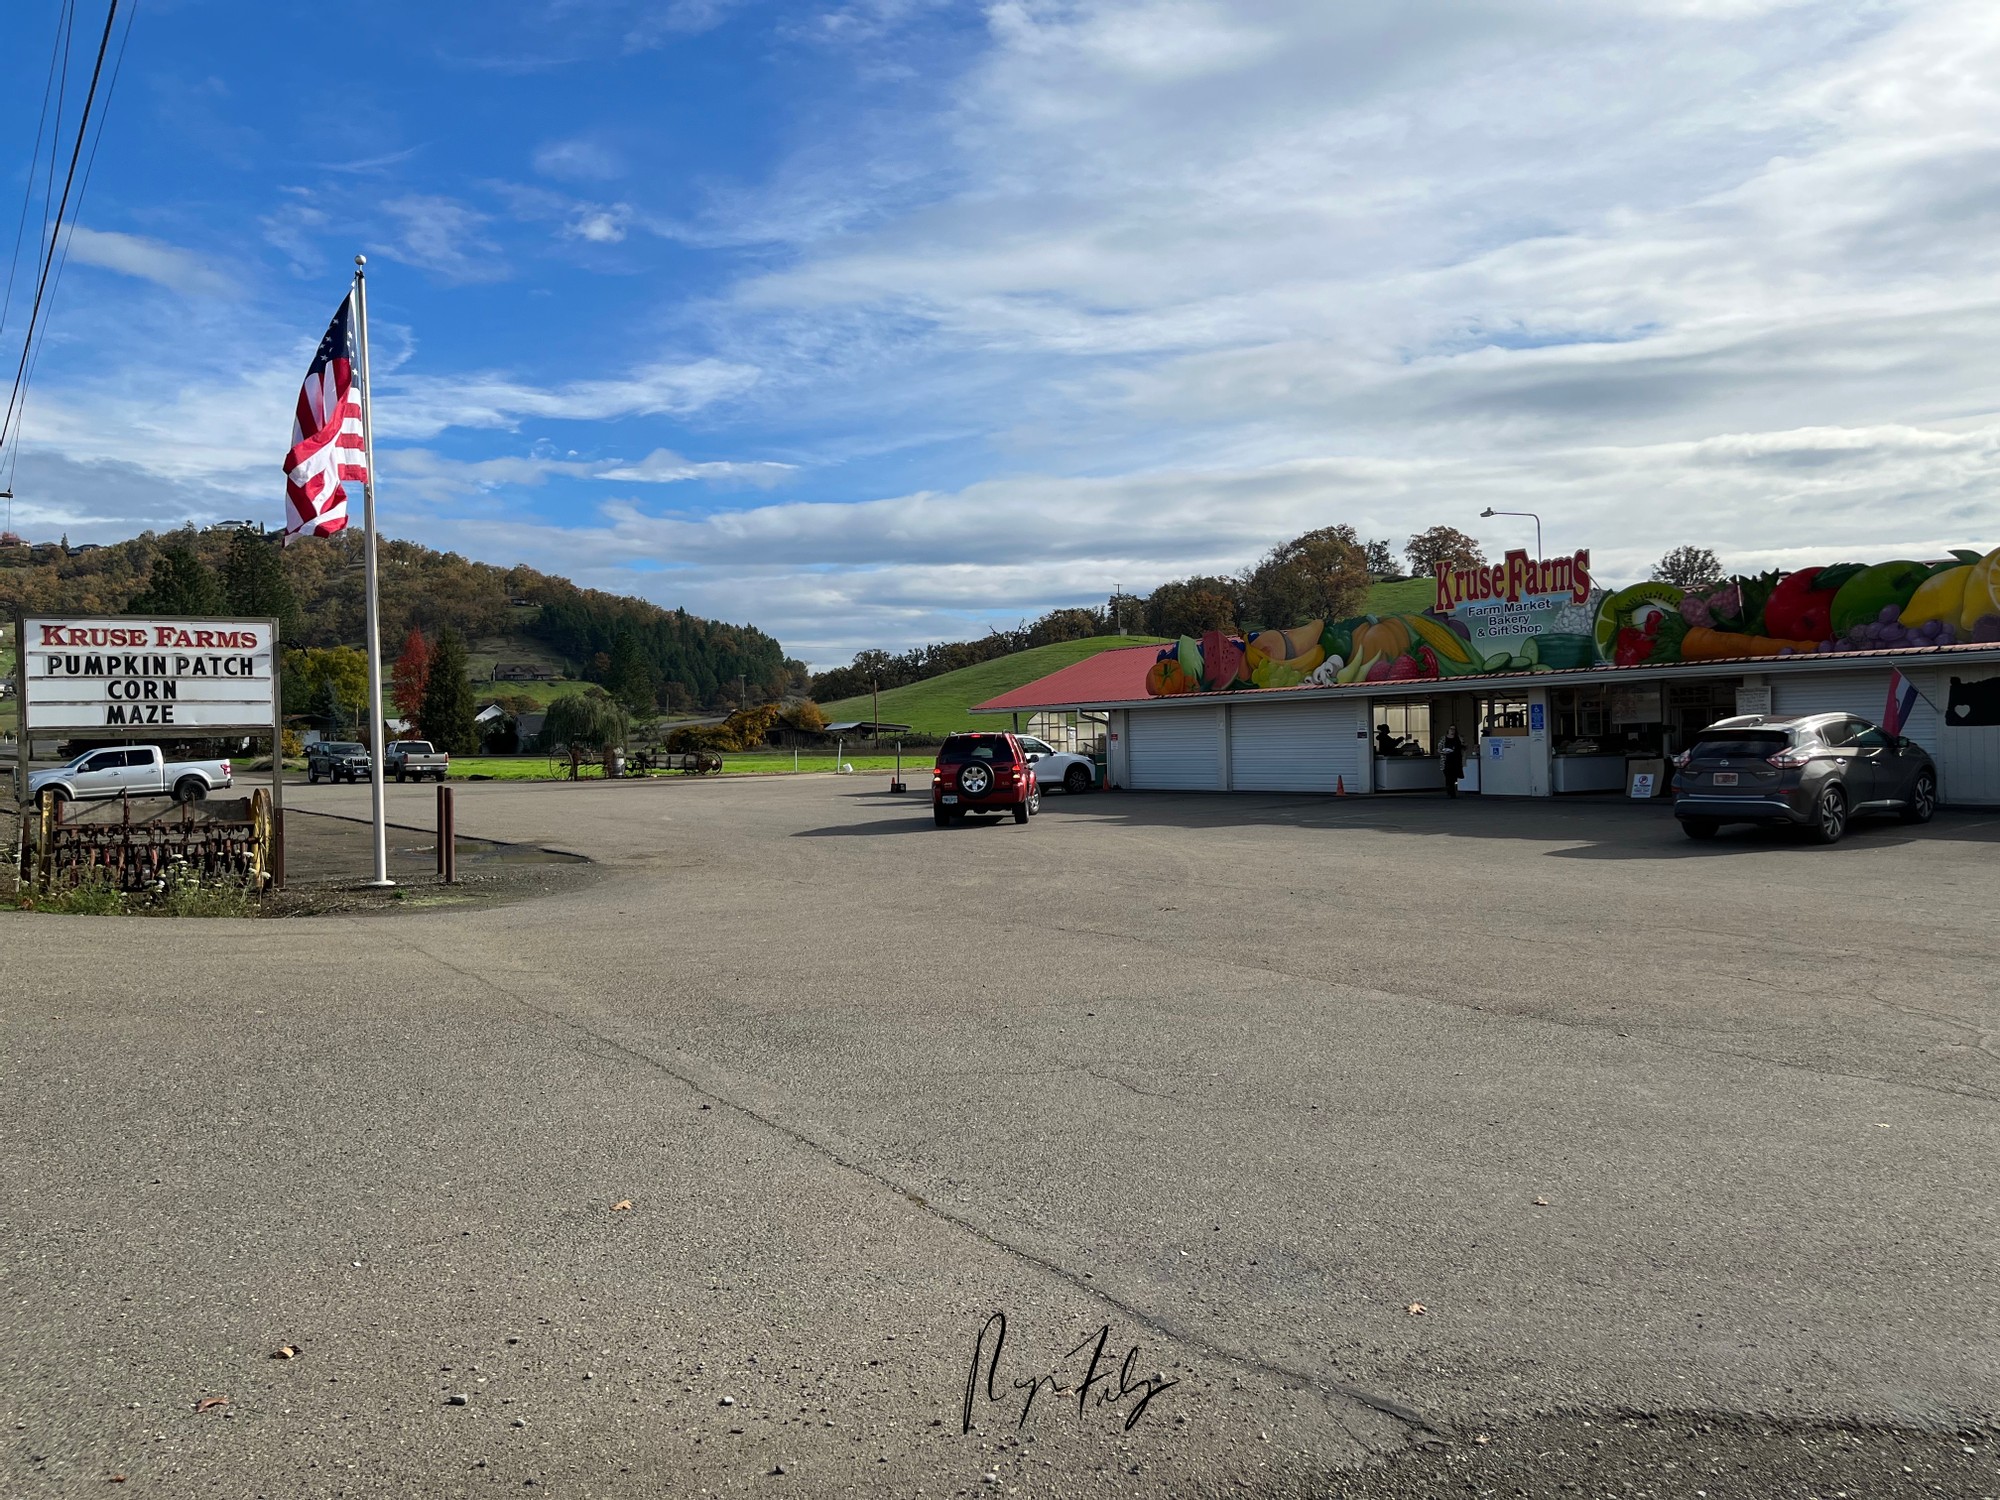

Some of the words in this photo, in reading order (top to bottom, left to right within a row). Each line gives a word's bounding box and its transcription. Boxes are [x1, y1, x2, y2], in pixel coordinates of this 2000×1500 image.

[1468, 605, 1500, 616] Farm
[1504, 600, 1551, 613] Market
[1489, 615, 1531, 626] Bakery
[40, 625, 148, 647] KRUSE
[154, 626, 258, 649] FARMS
[1477, 628, 1486, 637] &
[1488, 626, 1510, 636] Gift
[1511, 624, 1542, 636] Shop
[47, 655, 167, 675] PUMPKIN
[176, 657, 254, 676] PATCH
[107, 680, 177, 699] CORN
[106, 705, 175, 724] MAZE
